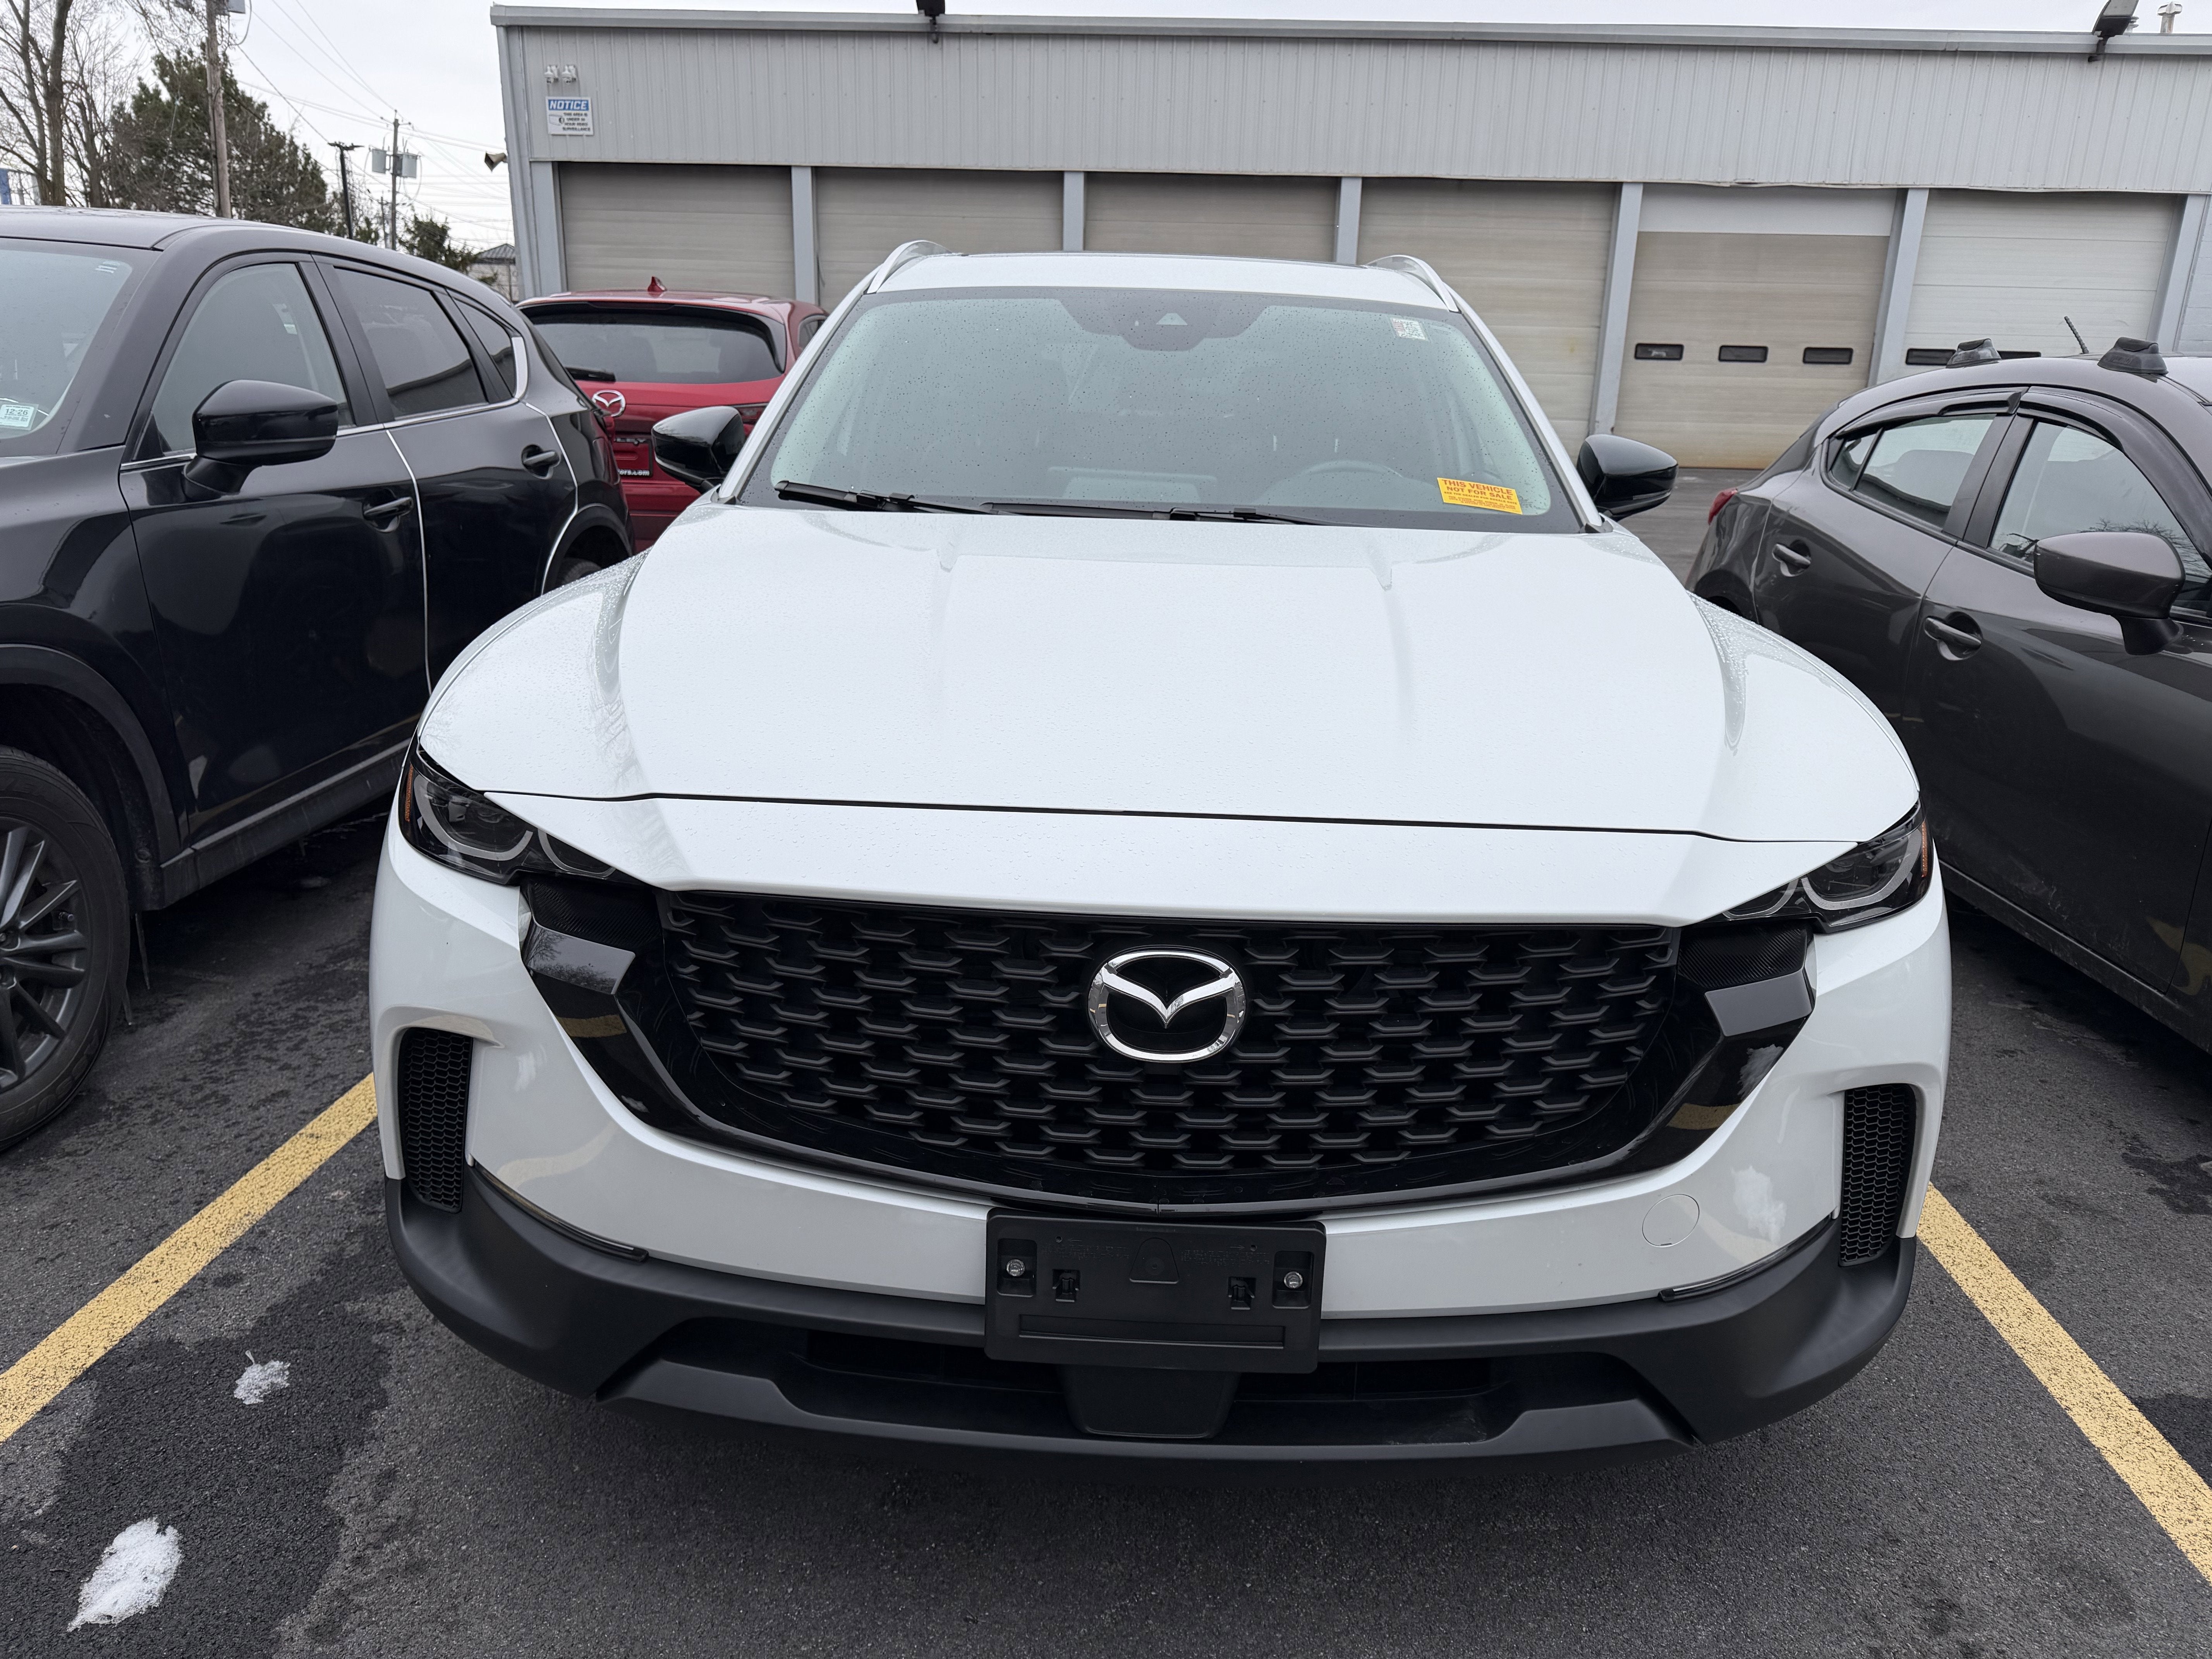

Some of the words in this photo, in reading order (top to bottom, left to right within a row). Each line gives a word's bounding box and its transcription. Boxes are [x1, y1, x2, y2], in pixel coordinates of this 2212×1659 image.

[550, 100, 587, 110] NOTICE
[1442, 479, 1466, 488] THIS
[1468, 483, 1513, 495] VEHICLE
[1489, 492, 1513, 500] SALE
